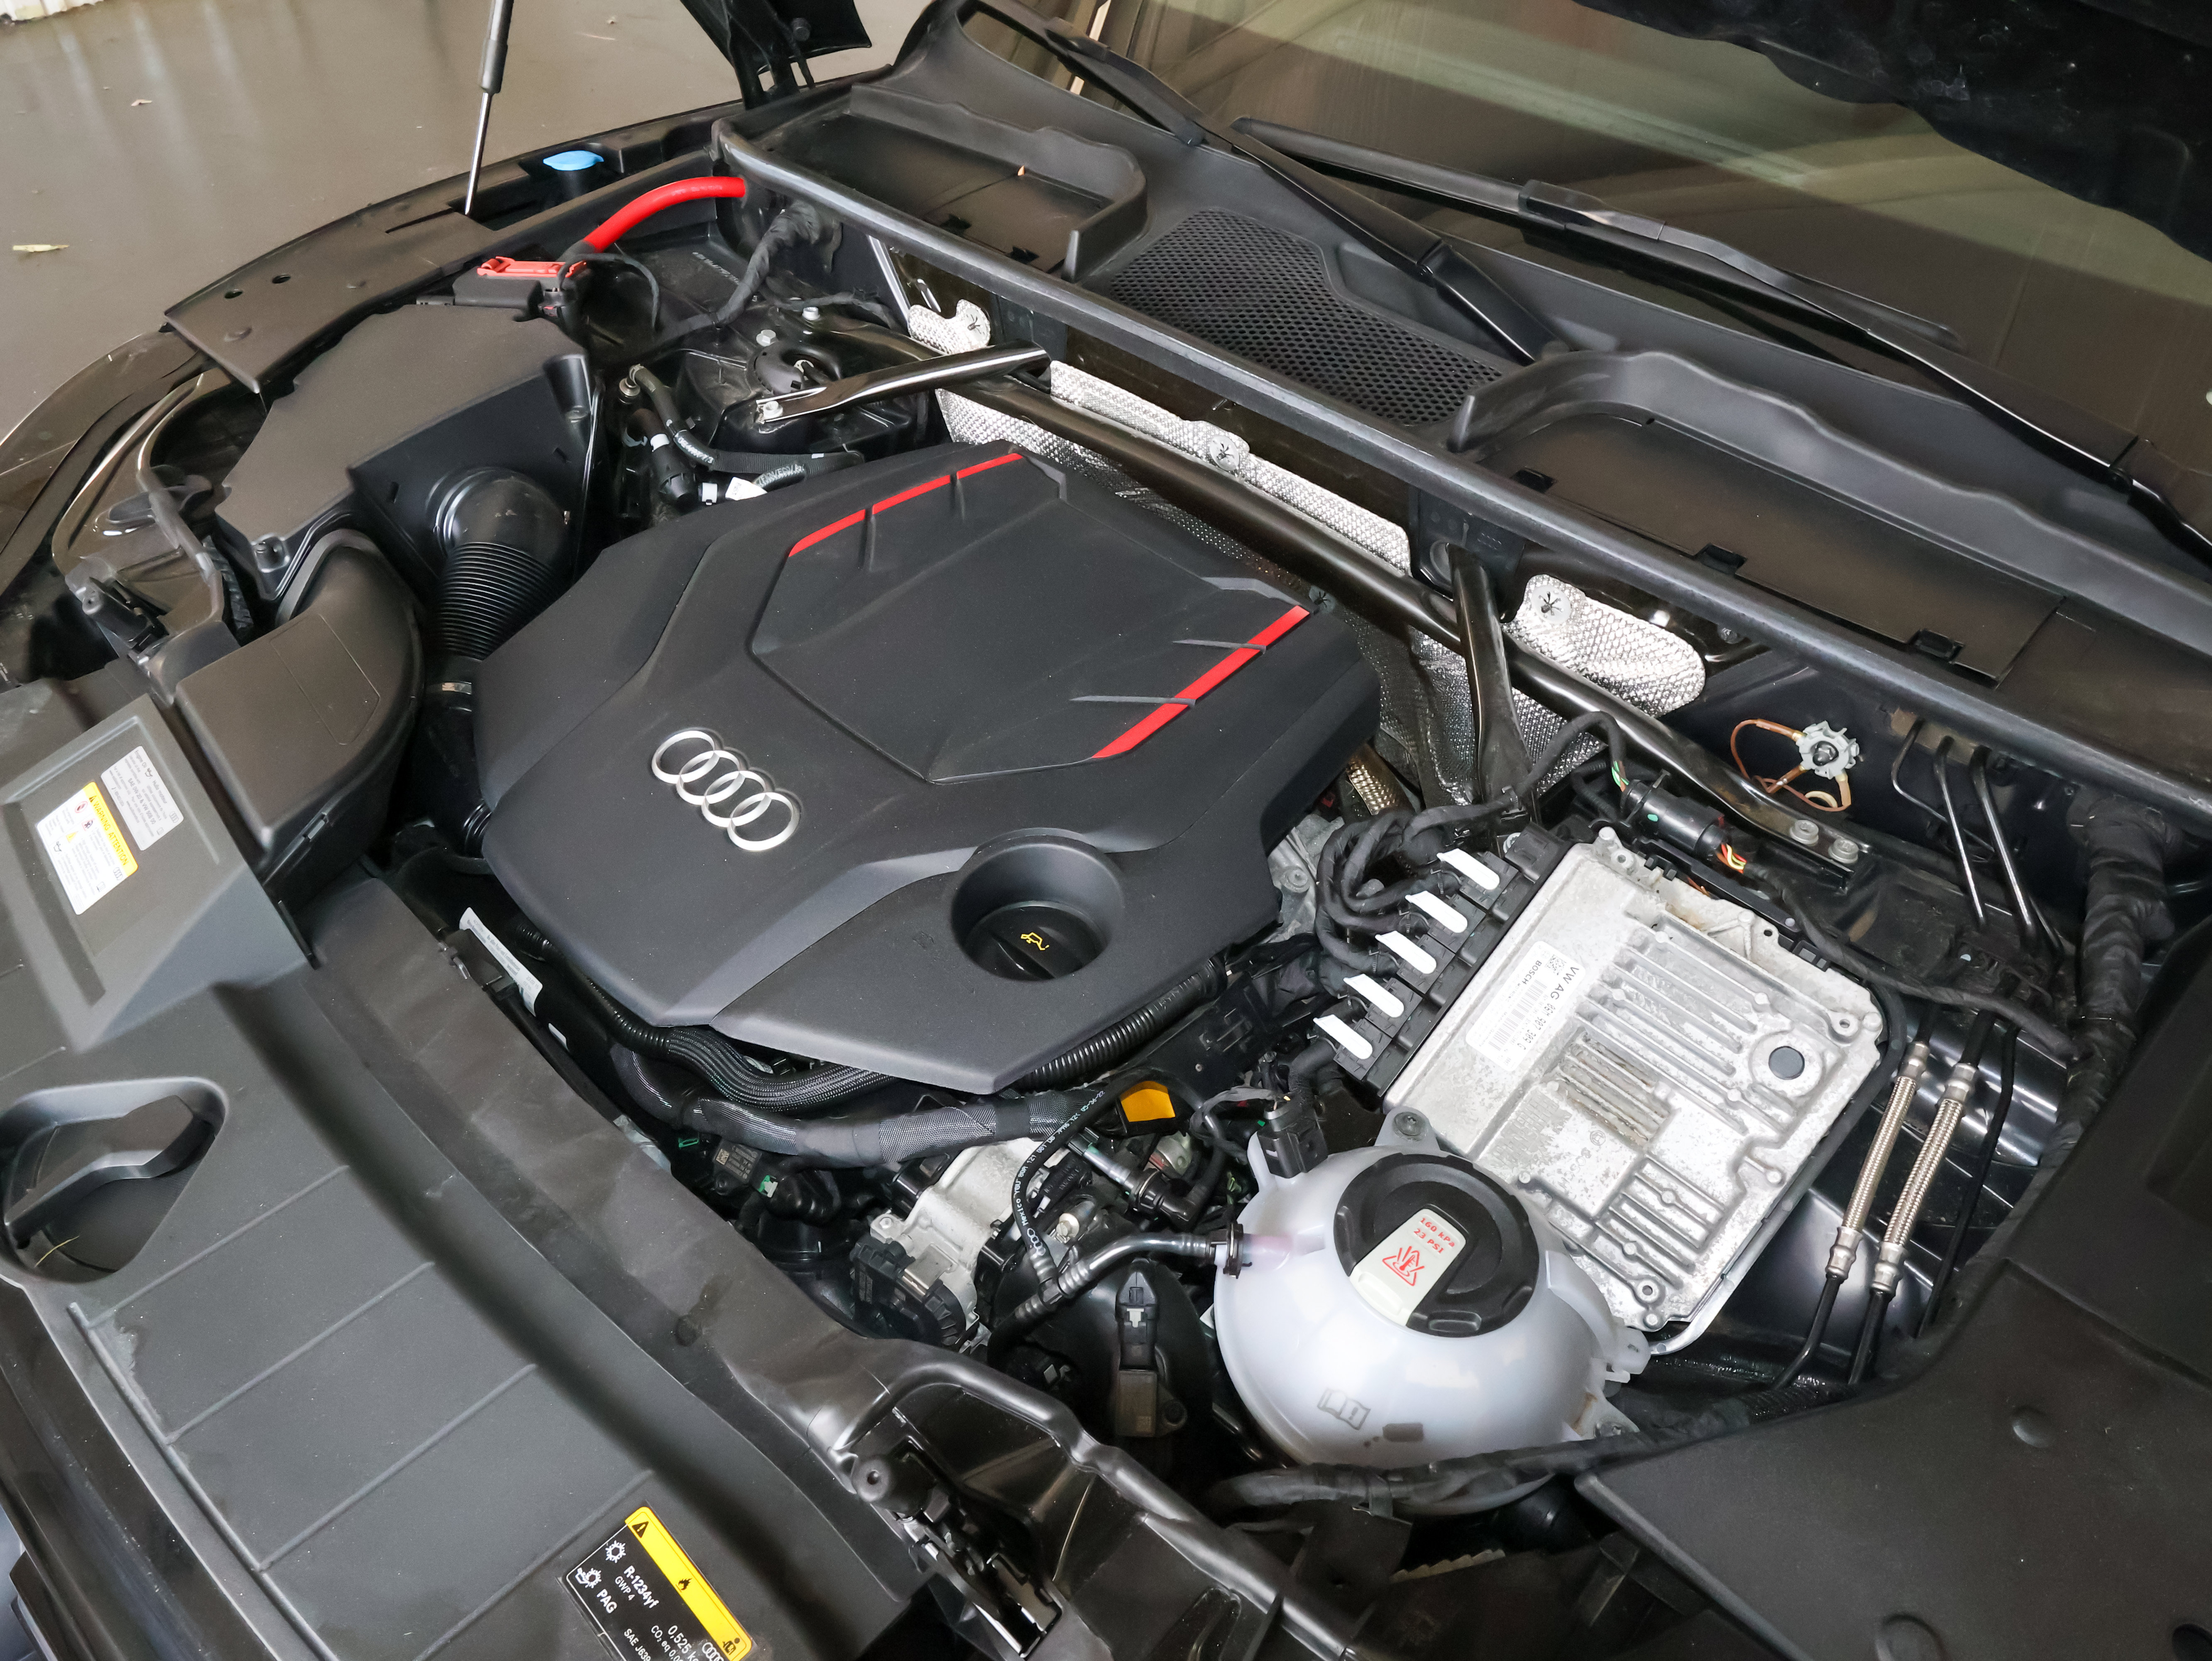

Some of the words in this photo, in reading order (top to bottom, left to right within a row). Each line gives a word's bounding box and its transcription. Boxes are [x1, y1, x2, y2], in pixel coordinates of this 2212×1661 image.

[142, 802, 149, 811] VW
[93, 803, 111, 831] WARNING
[108, 832, 129, 866] ATTENTION
[1522, 960, 1542, 985] BOSCH
[1563, 967, 1579, 984] VW
[1551, 983, 1564, 1000] AG
[1413, 1228, 1426, 1240] 23
[1427, 1239, 1444, 1254] PSI
[1420, 1217, 1437, 1232] 160
[1438, 1232, 1456, 1247] kPa
[597, 1589, 617, 1613] PAG
[624, 1629, 639, 1646] SAE
[615, 1576, 631, 1593] GWP
[661, 1641, 671, 1653] eq
[624, 1565, 659, 1608] R-1234yf
[668, 1625, 692, 1654] 0,525
